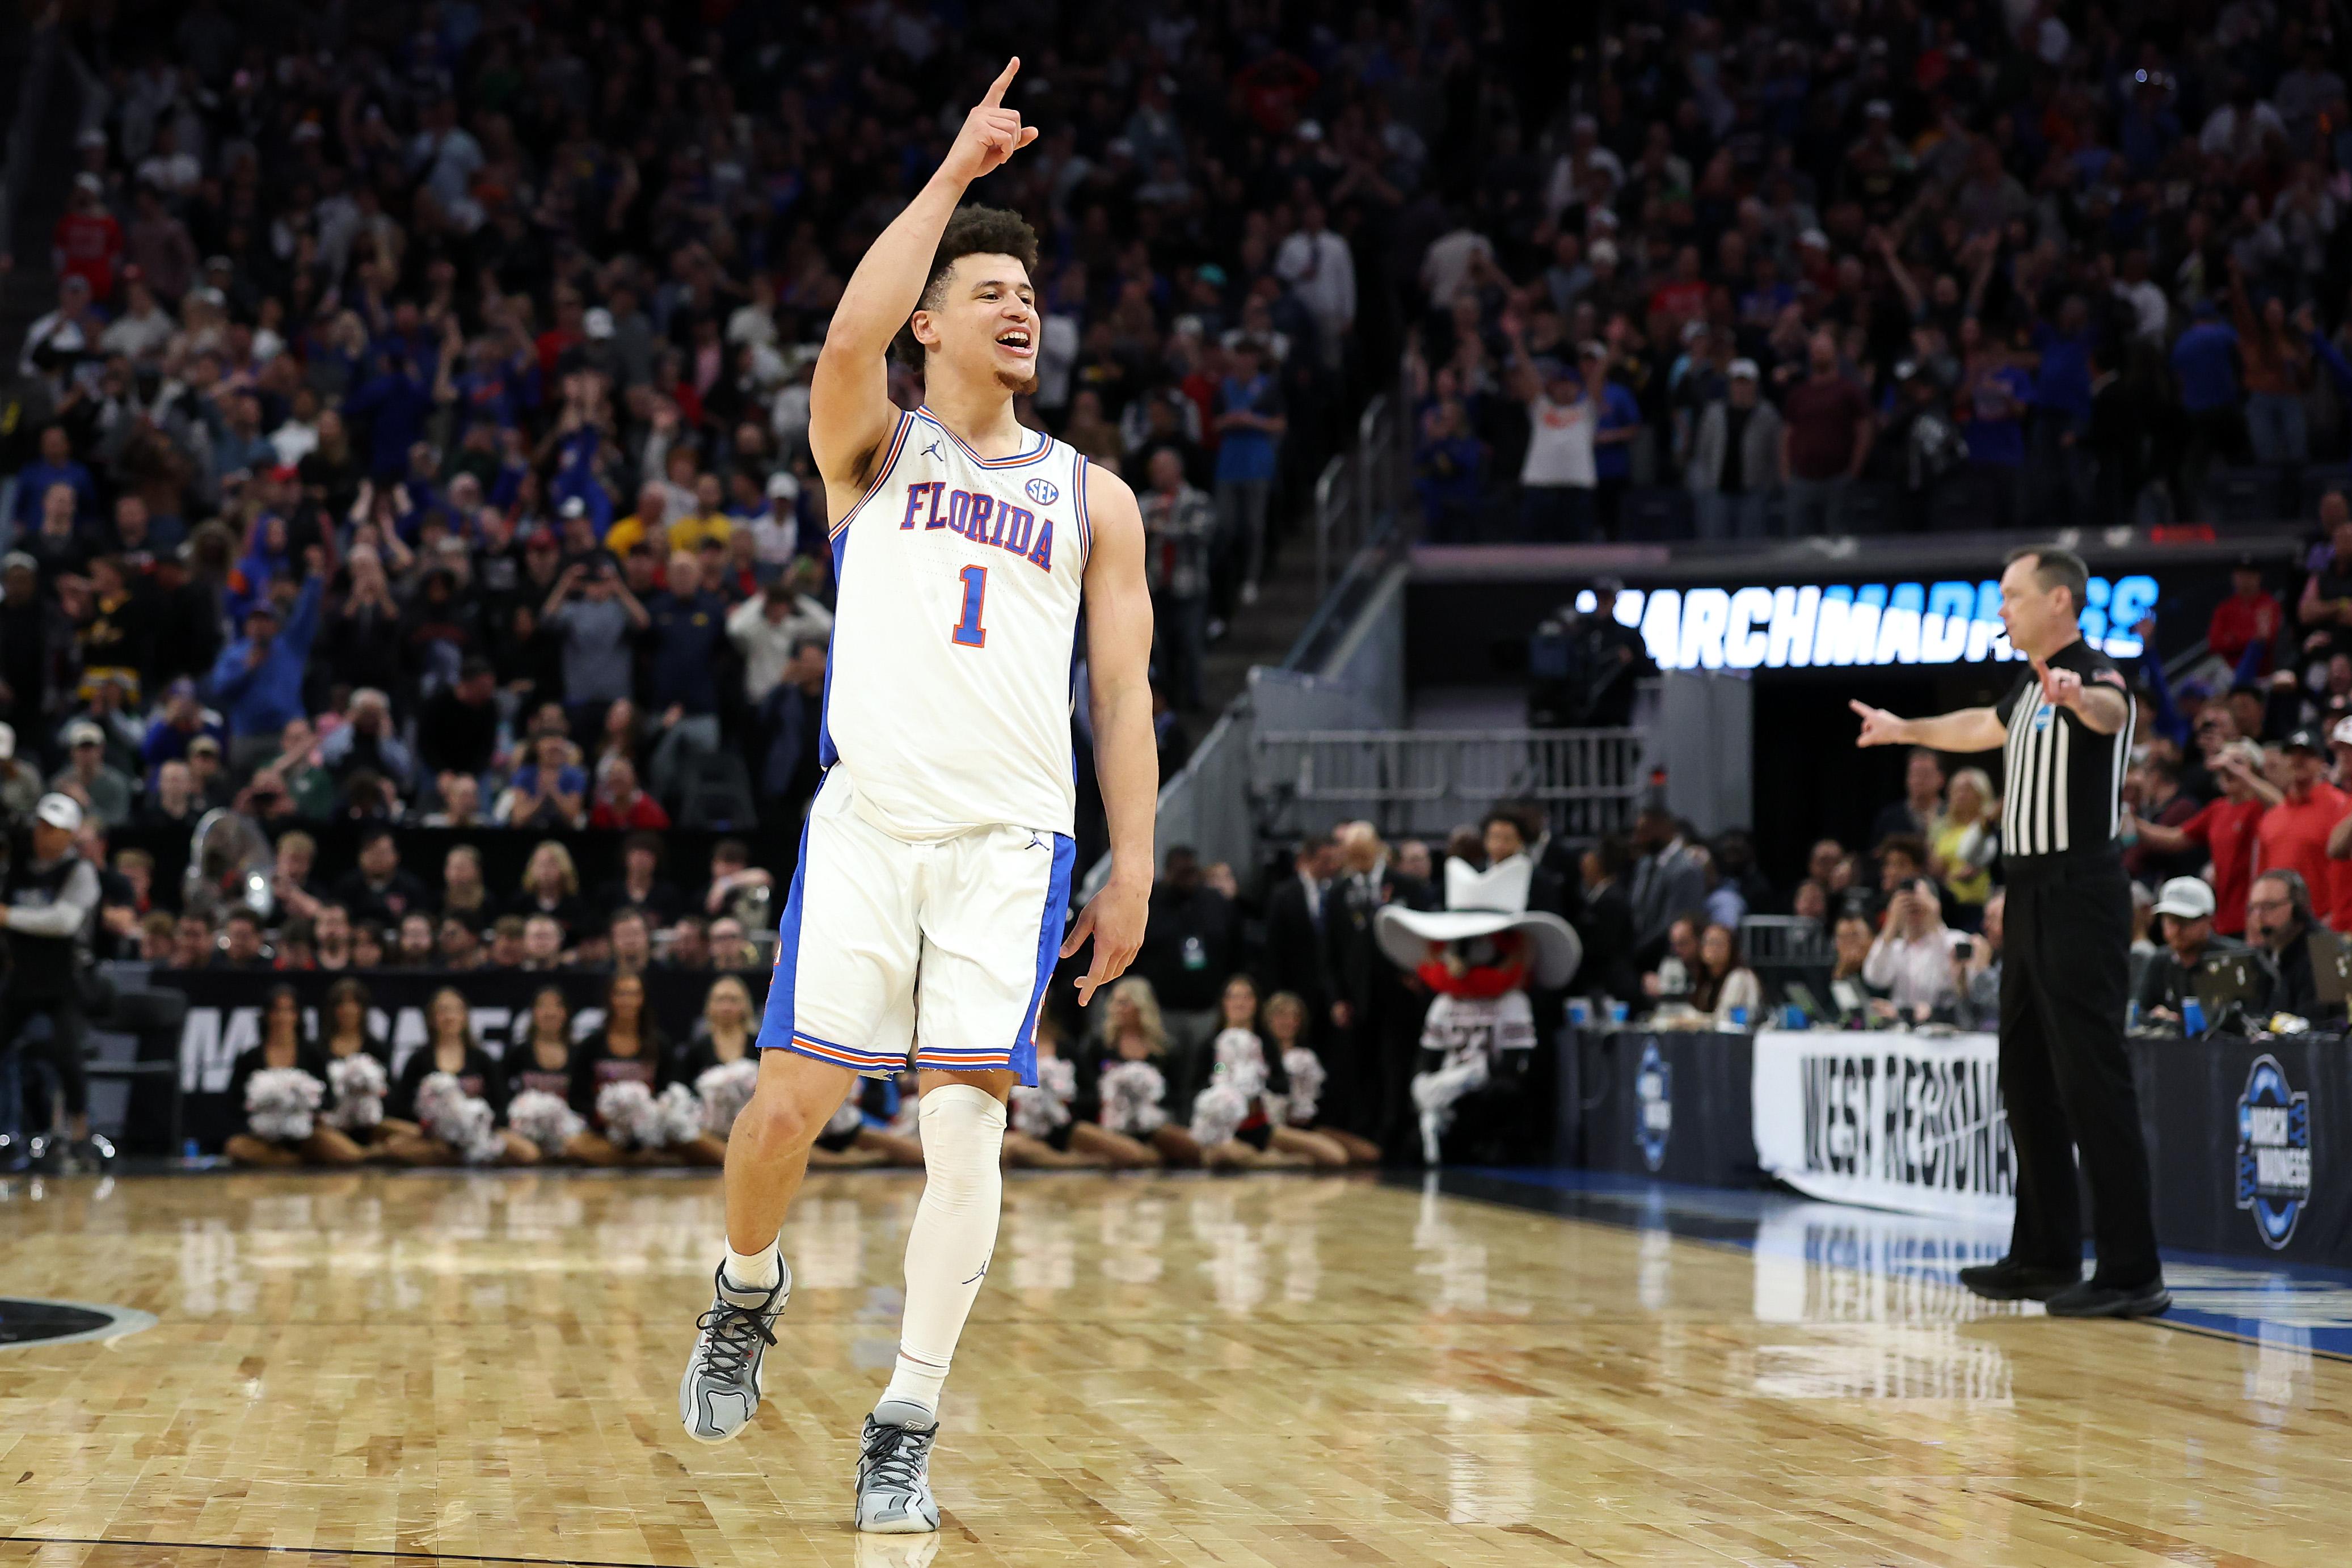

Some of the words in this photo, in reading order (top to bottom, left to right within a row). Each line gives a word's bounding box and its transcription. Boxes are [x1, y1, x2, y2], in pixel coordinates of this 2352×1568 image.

[900, 482, 1053, 574] FLORIDA
[1027, 479, 1058, 504] SEC
[952, 564, 988, 648] 1
[1803, 1056, 1875, 1176] WEST
